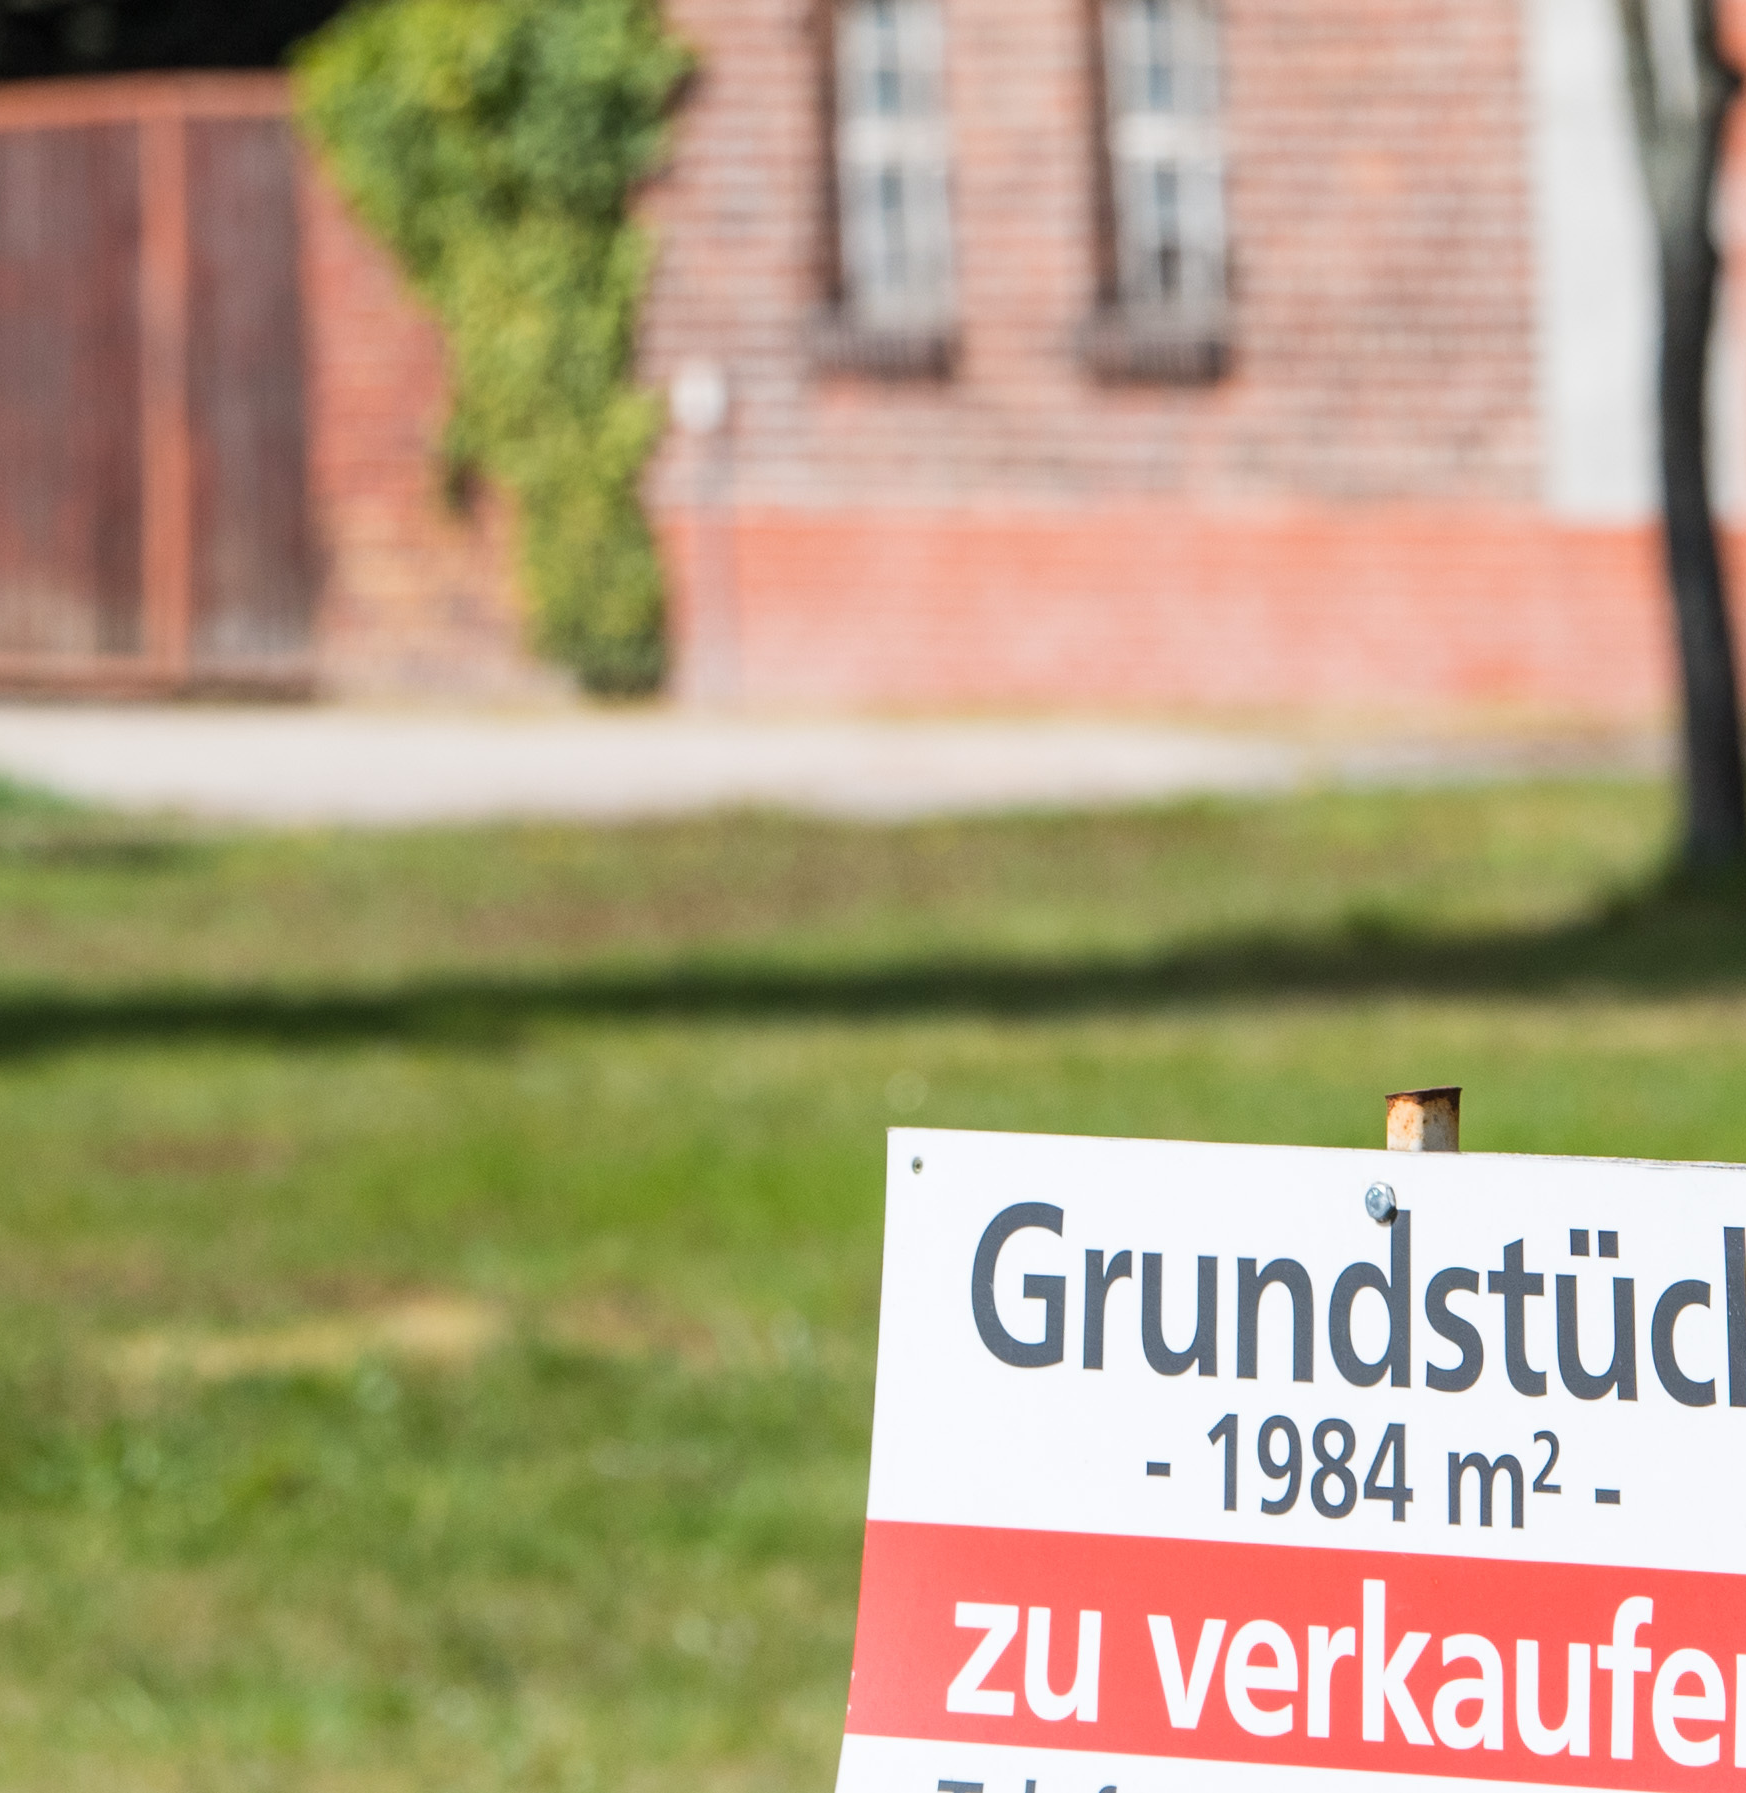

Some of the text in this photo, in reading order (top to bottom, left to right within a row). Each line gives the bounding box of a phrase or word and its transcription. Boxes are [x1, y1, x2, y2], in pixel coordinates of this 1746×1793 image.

[1145, 1412, 1622, 1530] - 1984 m² -
[944, 1600, 1103, 1724] zu
